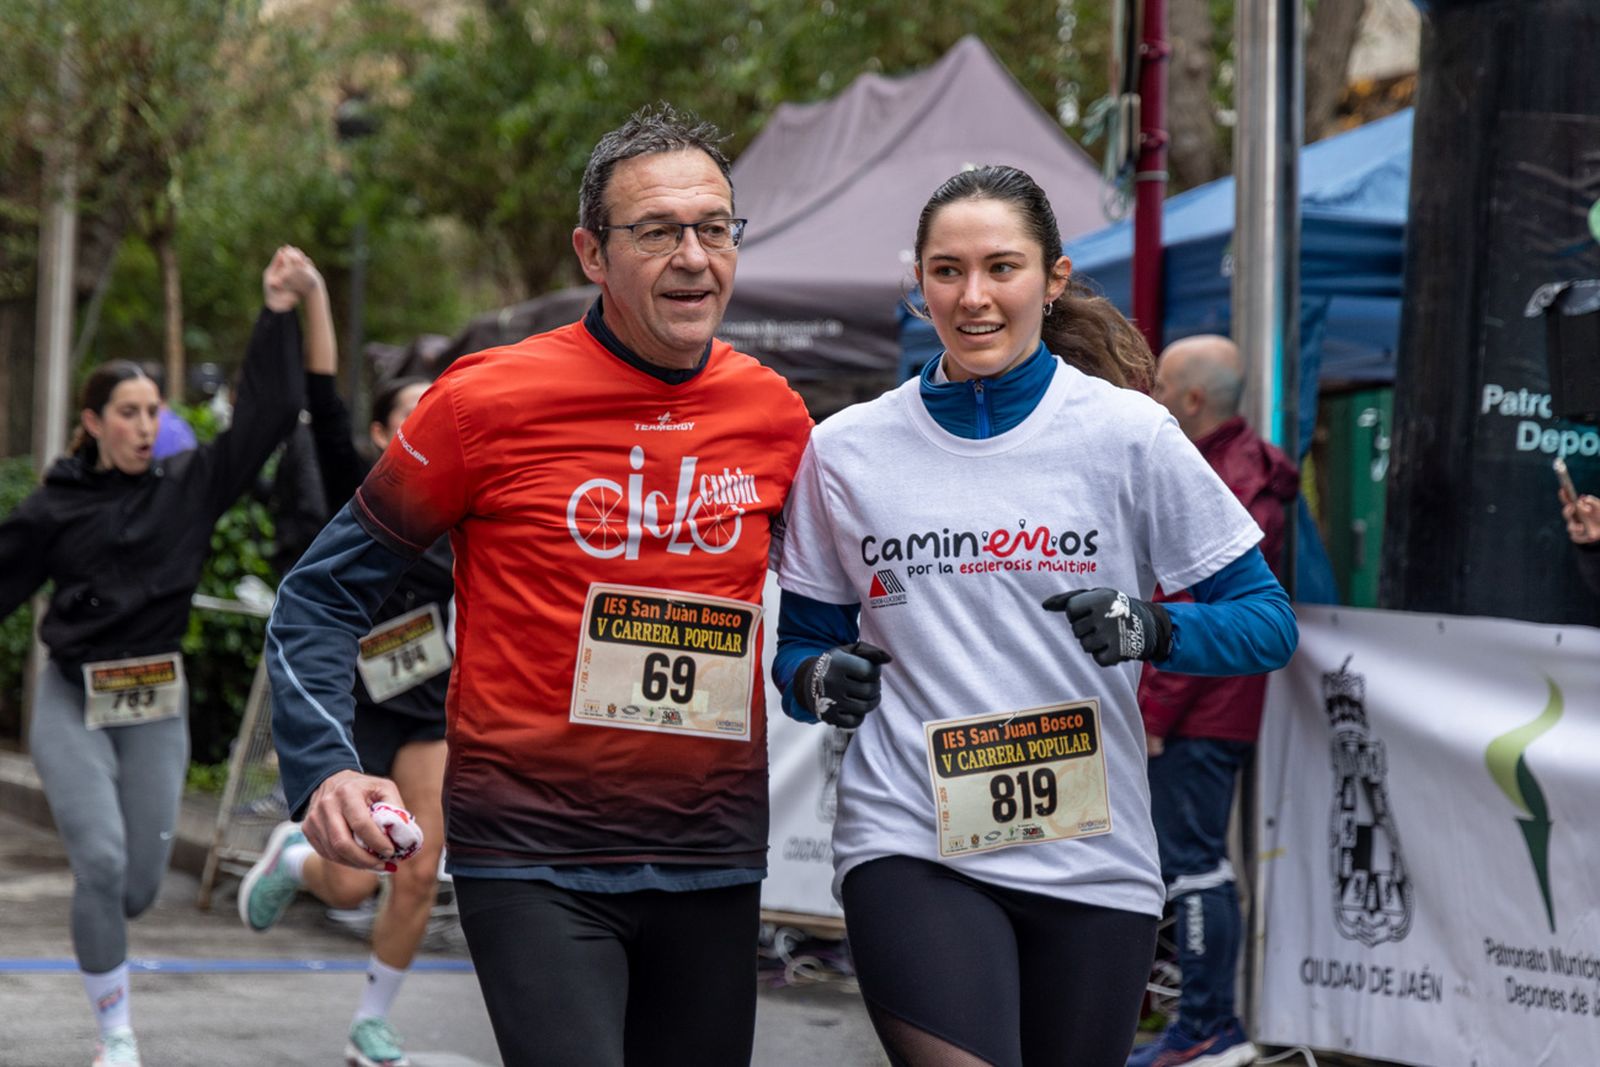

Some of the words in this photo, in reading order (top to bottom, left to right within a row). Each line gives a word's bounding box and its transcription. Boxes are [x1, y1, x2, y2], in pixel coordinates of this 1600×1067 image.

[1517, 421, 1600, 458] Depo
[907, 564, 933, 578] por
[939, 562, 954, 574] la
[960, 558, 1032, 574] esclerosis
[603, 597, 628, 616] IES
[631, 600, 661, 619] San
[664, 603, 698, 623] Juan
[701, 608, 742, 628] Bosco
[597, 617, 608, 637] V
[611, 618, 680, 646] CARRERA
[684, 627, 742, 653] POPULAR
[641, 652, 696, 705] 69
[943, 731, 965, 749] IES
[969, 726, 999, 745] San
[1004, 722, 1037, 740] Juan
[1041, 713, 1084, 733] Bosco
[941, 754, 952, 773] V
[957, 743, 1025, 771] CARRERA
[1028, 732, 1092, 758] POPULAR
[990, 767, 1057, 823] 819
[1483, 936, 1547, 973] Patronato
[1299, 956, 1366, 992] CIUDAD
[1369, 964, 1394, 996] DE
[1397, 964, 1443, 1003] JAÉN
[1505, 975, 1566, 1014] Deportes
[1569, 986, 1588, 1014] de
